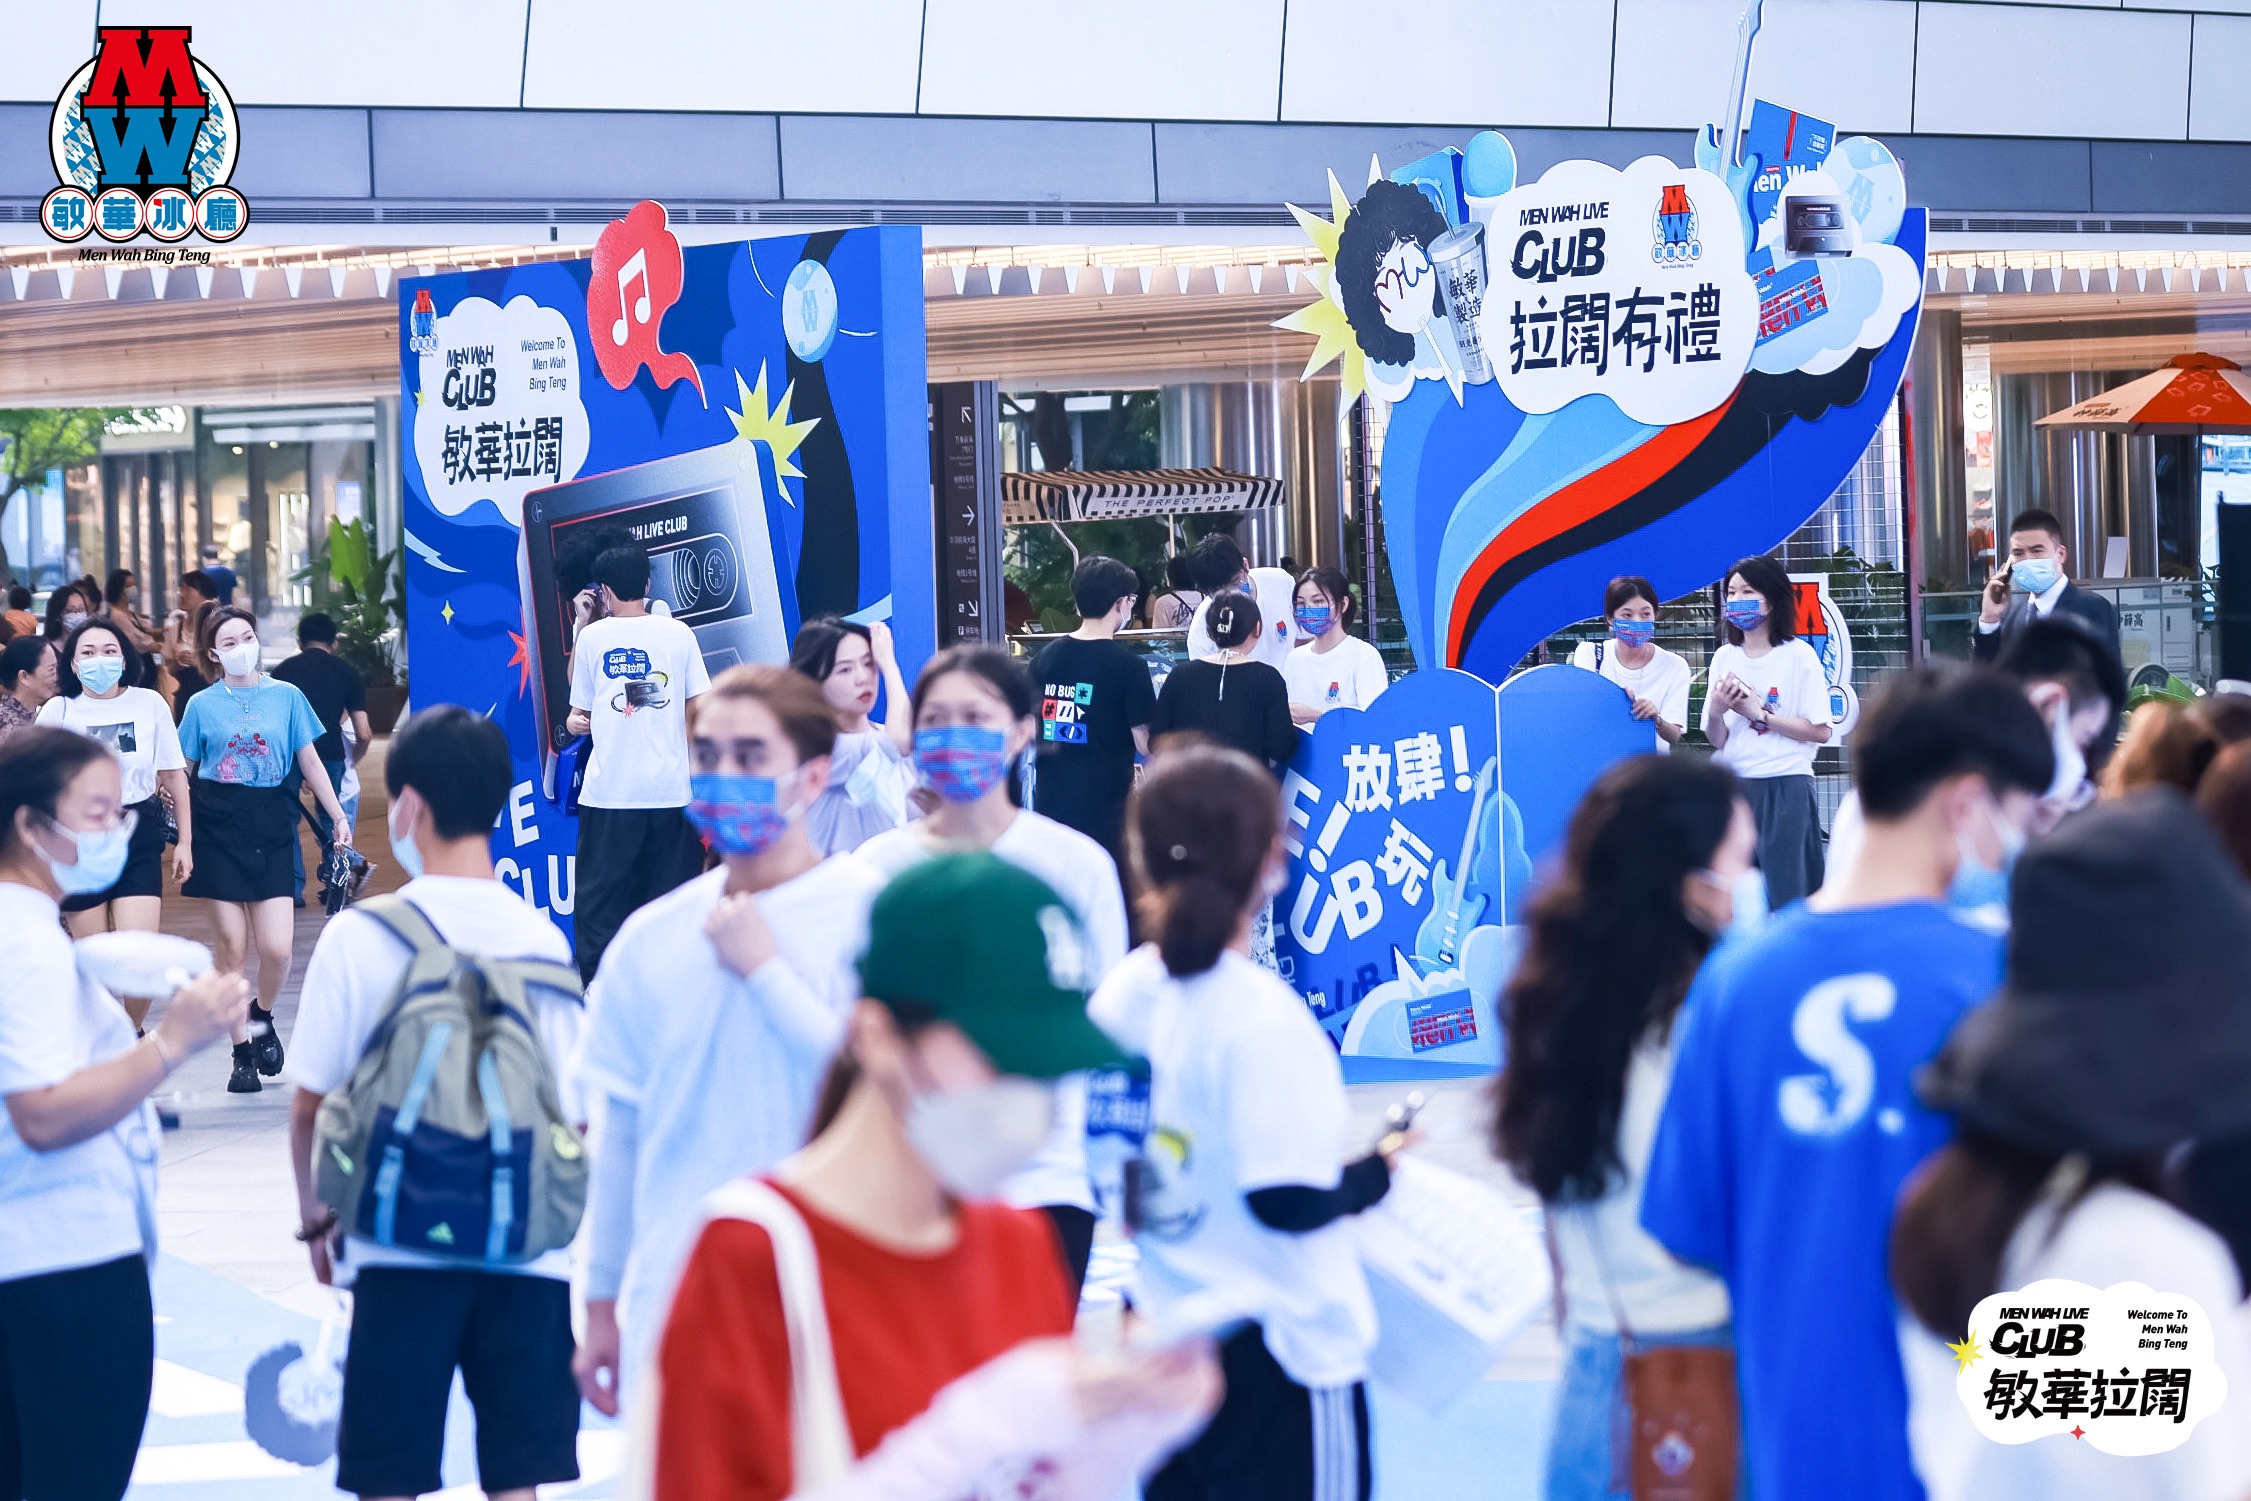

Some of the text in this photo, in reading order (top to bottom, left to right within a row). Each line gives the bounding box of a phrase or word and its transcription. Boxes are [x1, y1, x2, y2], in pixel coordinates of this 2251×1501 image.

[1754, 172, 1782, 193] en
[1519, 202, 1609, 226] MEN WAH LIVE
[1510, 227, 1606, 283] CLUB
[1510, 283, 1721, 376] 拉闊有禮
[521, 337, 565, 352] Welcome To
[447, 345, 494, 370] MEN WAH
[532, 357, 566, 370] Men Wah
[442, 368, 496, 411] CLUB
[529, 377, 566, 392] Bing Teng
[441, 417, 563, 485] 敏華拉闊
[1105, 495, 1230, 508] THE PERFECT POP
[629, 515, 688, 541] AH LIVE CLUB
[1044, 684, 1057, 697] NO
[1375, 817, 1434, 907] 玩
[1306, 991, 1327, 1008] Teng
